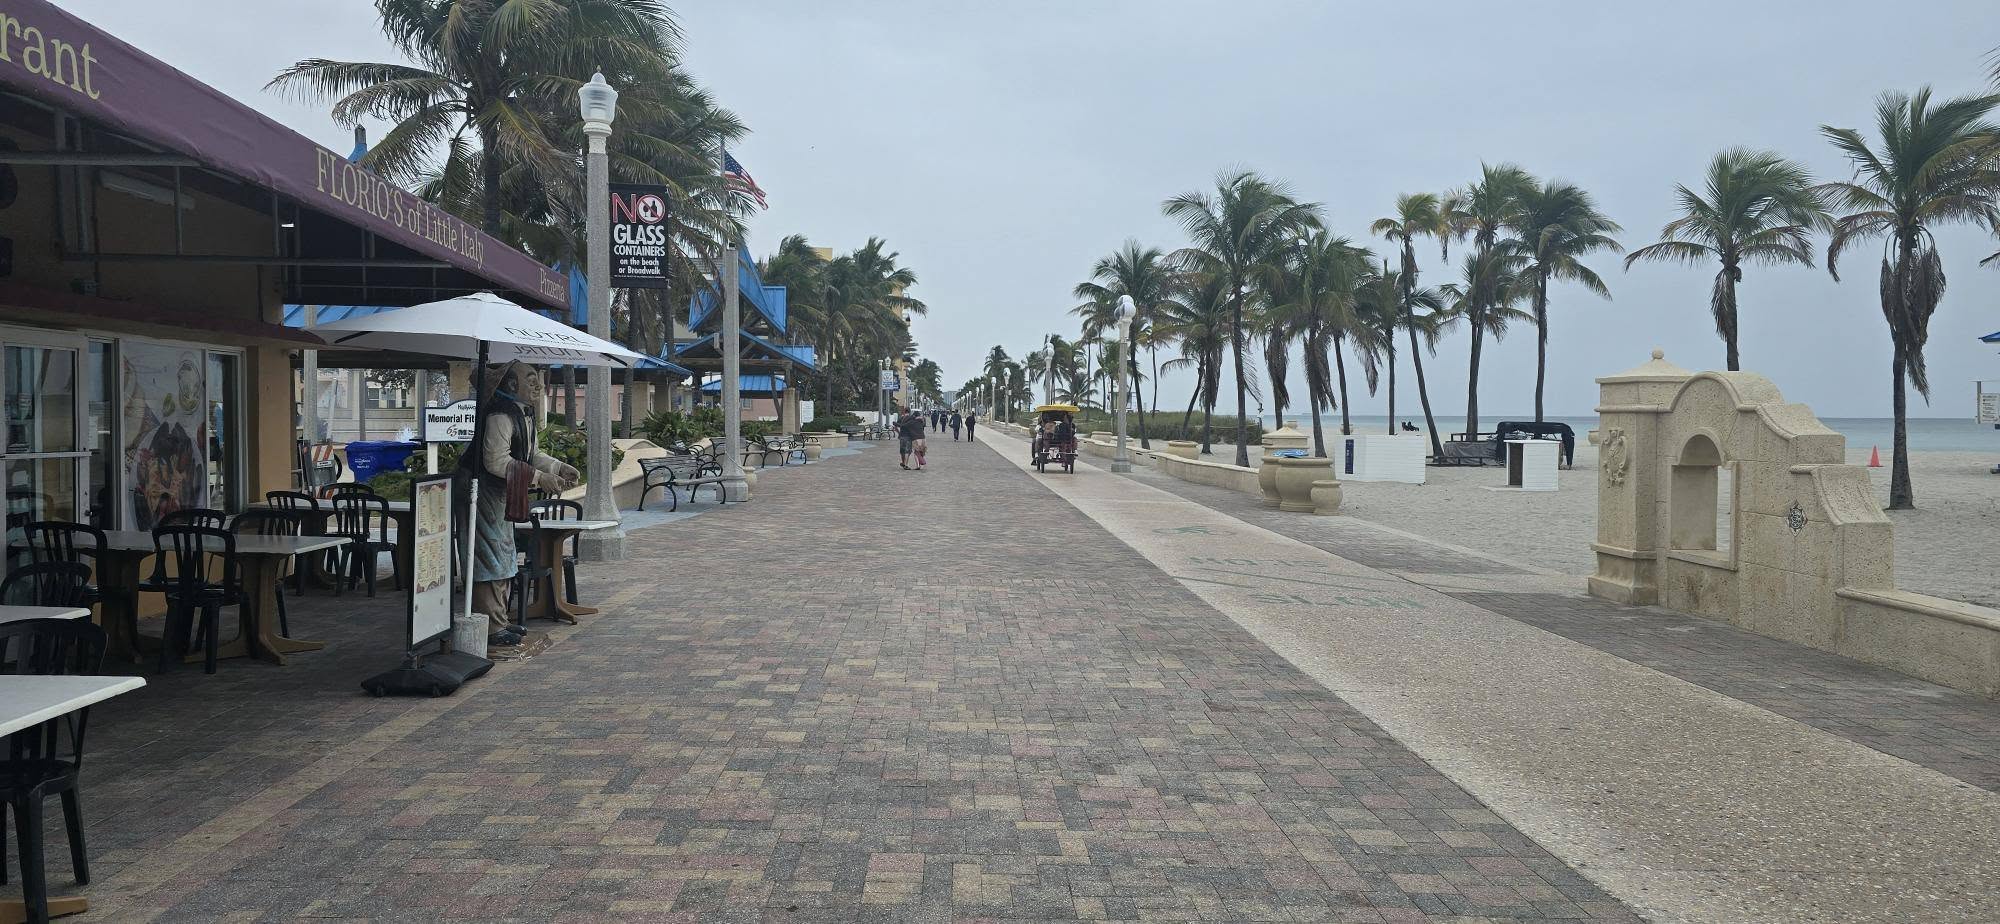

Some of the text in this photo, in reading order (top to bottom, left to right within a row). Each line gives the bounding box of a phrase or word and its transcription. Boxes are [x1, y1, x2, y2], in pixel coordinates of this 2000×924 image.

[0, 13, 100, 99] rant
[316, 147, 484, 267] FLORIO'S of Little Italy
[612, 193, 665, 224] NO
[613, 224, 665, 245] GLASS
[613, 245, 665, 256] CONTAINERS
[627, 266, 661, 275] Broadwalk
[629, 257, 640, 266] the
[641, 257, 660, 266] beach
[540, 268, 565, 302] Pizzeria
[428, 413, 463, 423] Memorial
